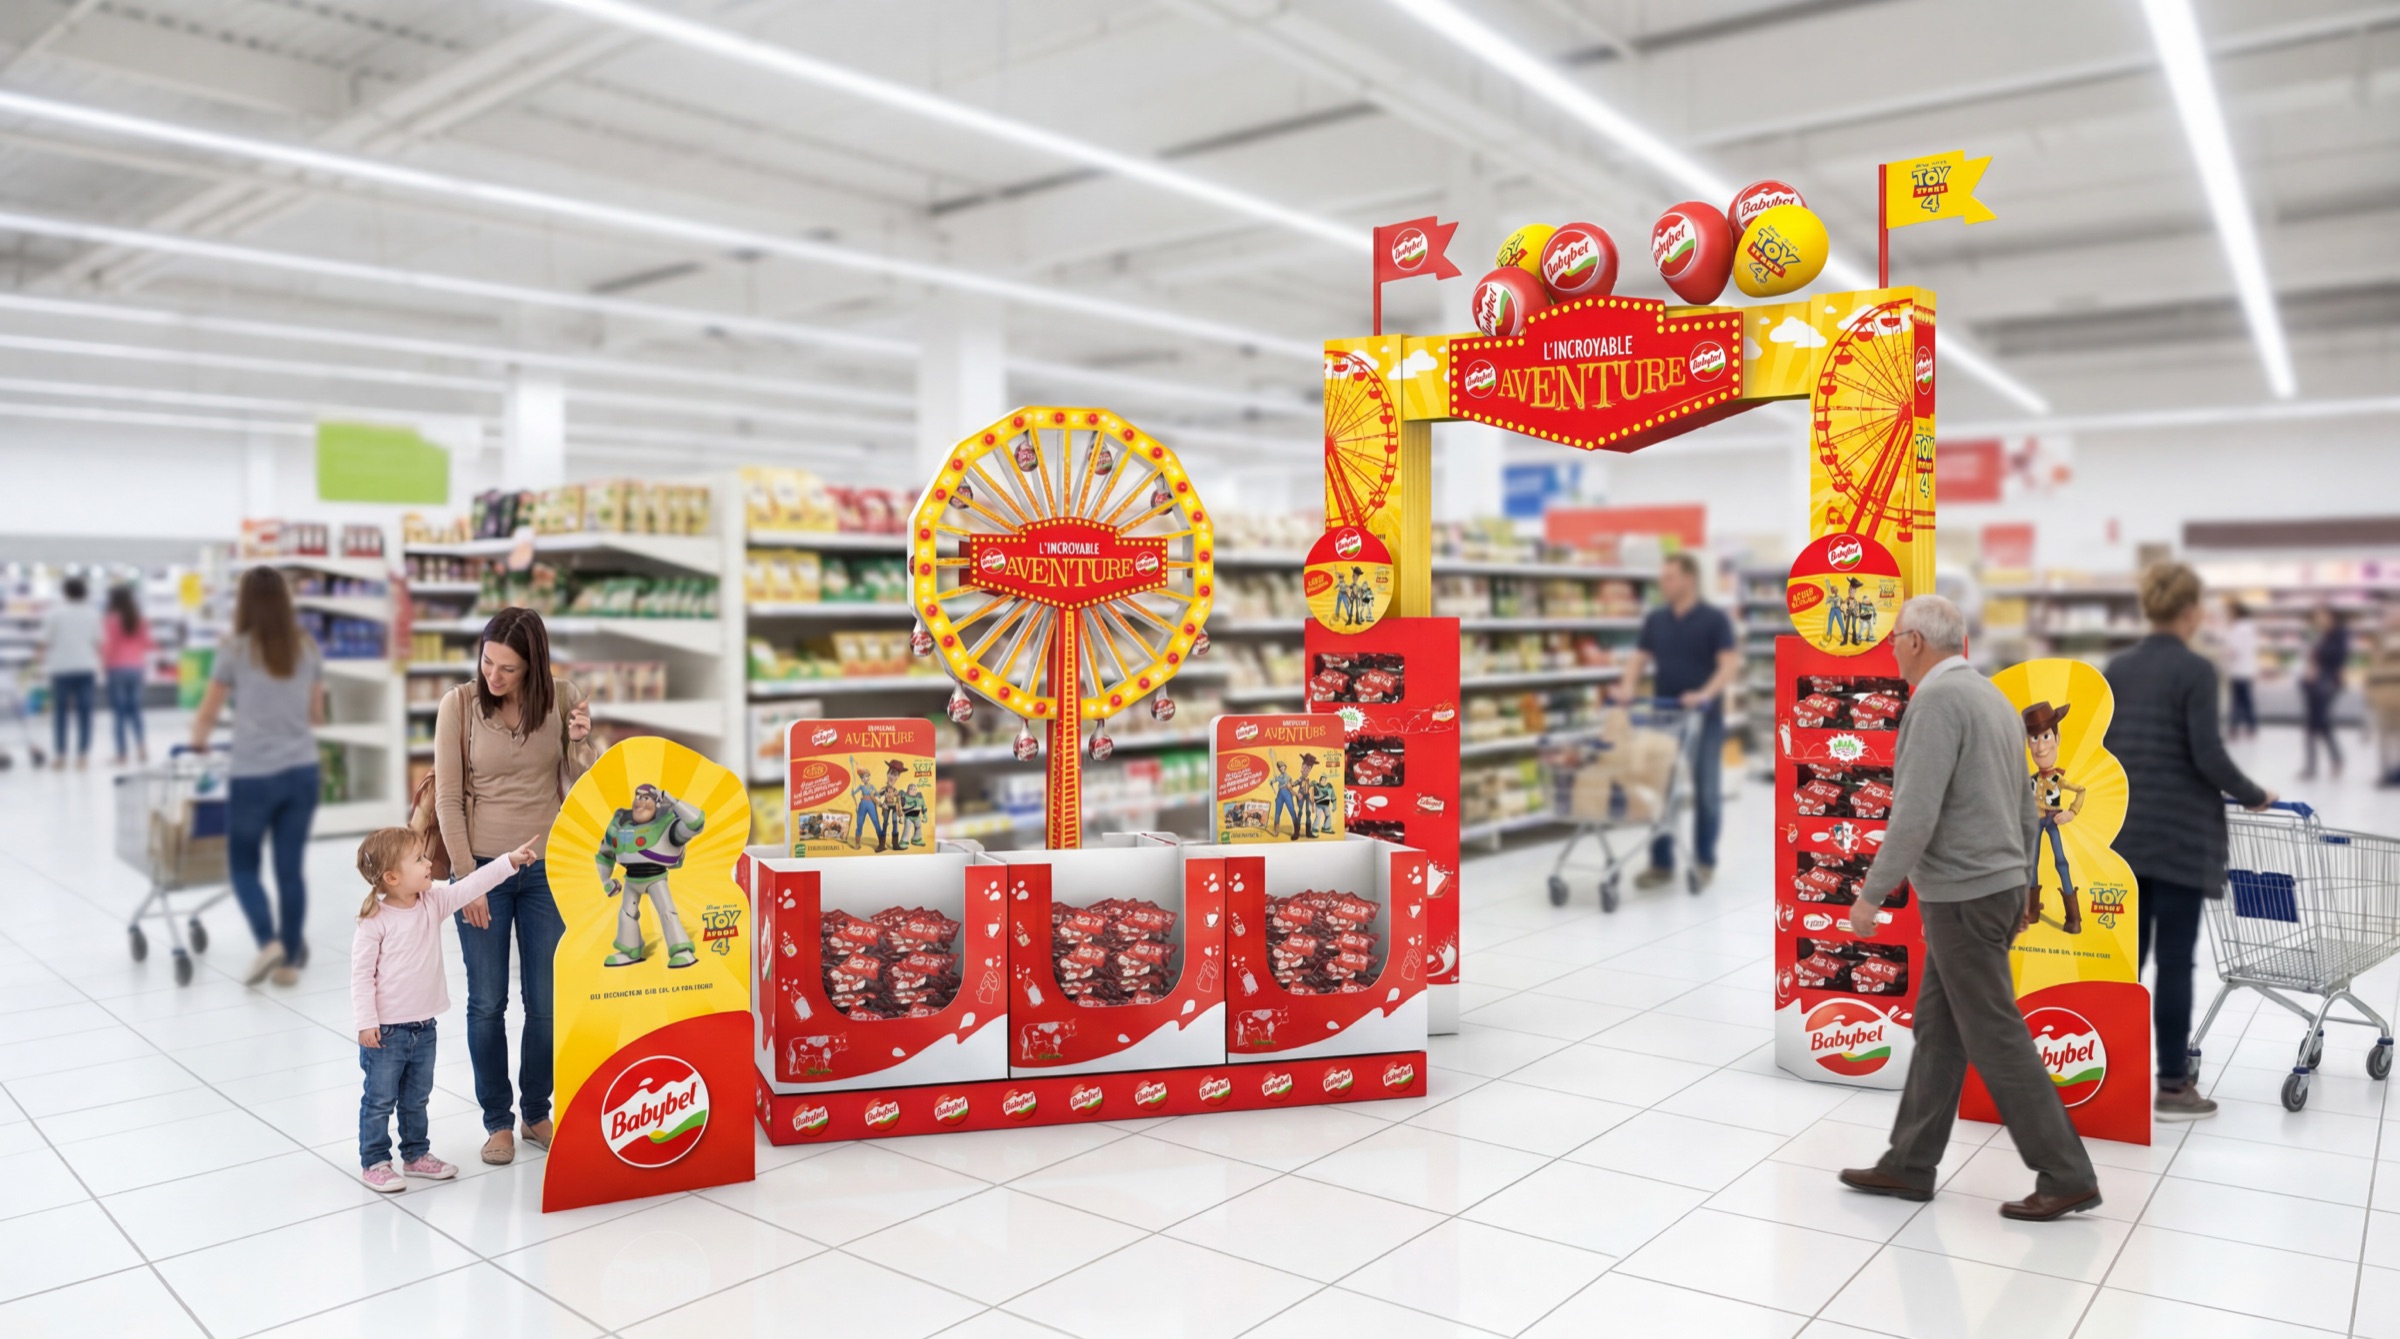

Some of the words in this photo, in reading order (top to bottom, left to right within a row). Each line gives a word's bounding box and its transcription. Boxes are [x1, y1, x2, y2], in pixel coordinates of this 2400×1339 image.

[1912, 165, 1951, 187] TOY
[1920, 194, 1940, 213] 4
[1757, 227, 1802, 268] TOY
[1749, 262, 1770, 283] 4
[1543, 335, 1634, 361] L'INCROYABLE
[1498, 357, 1686, 411] AVENTURE
[1004, 556, 1134, 588] AVENTURE
[844, 731, 915, 749] AVENTURE
[2090, 888, 2128, 905] TOY
[702, 910, 741, 930] TOY
[2097, 911, 2116, 929] 4
[711, 938, 731, 956] 4
[1811, 1025, 1884, 1051] Babybel
[2041, 1039, 2095, 1073] bybel
[611, 1081, 697, 1141] Babybel
